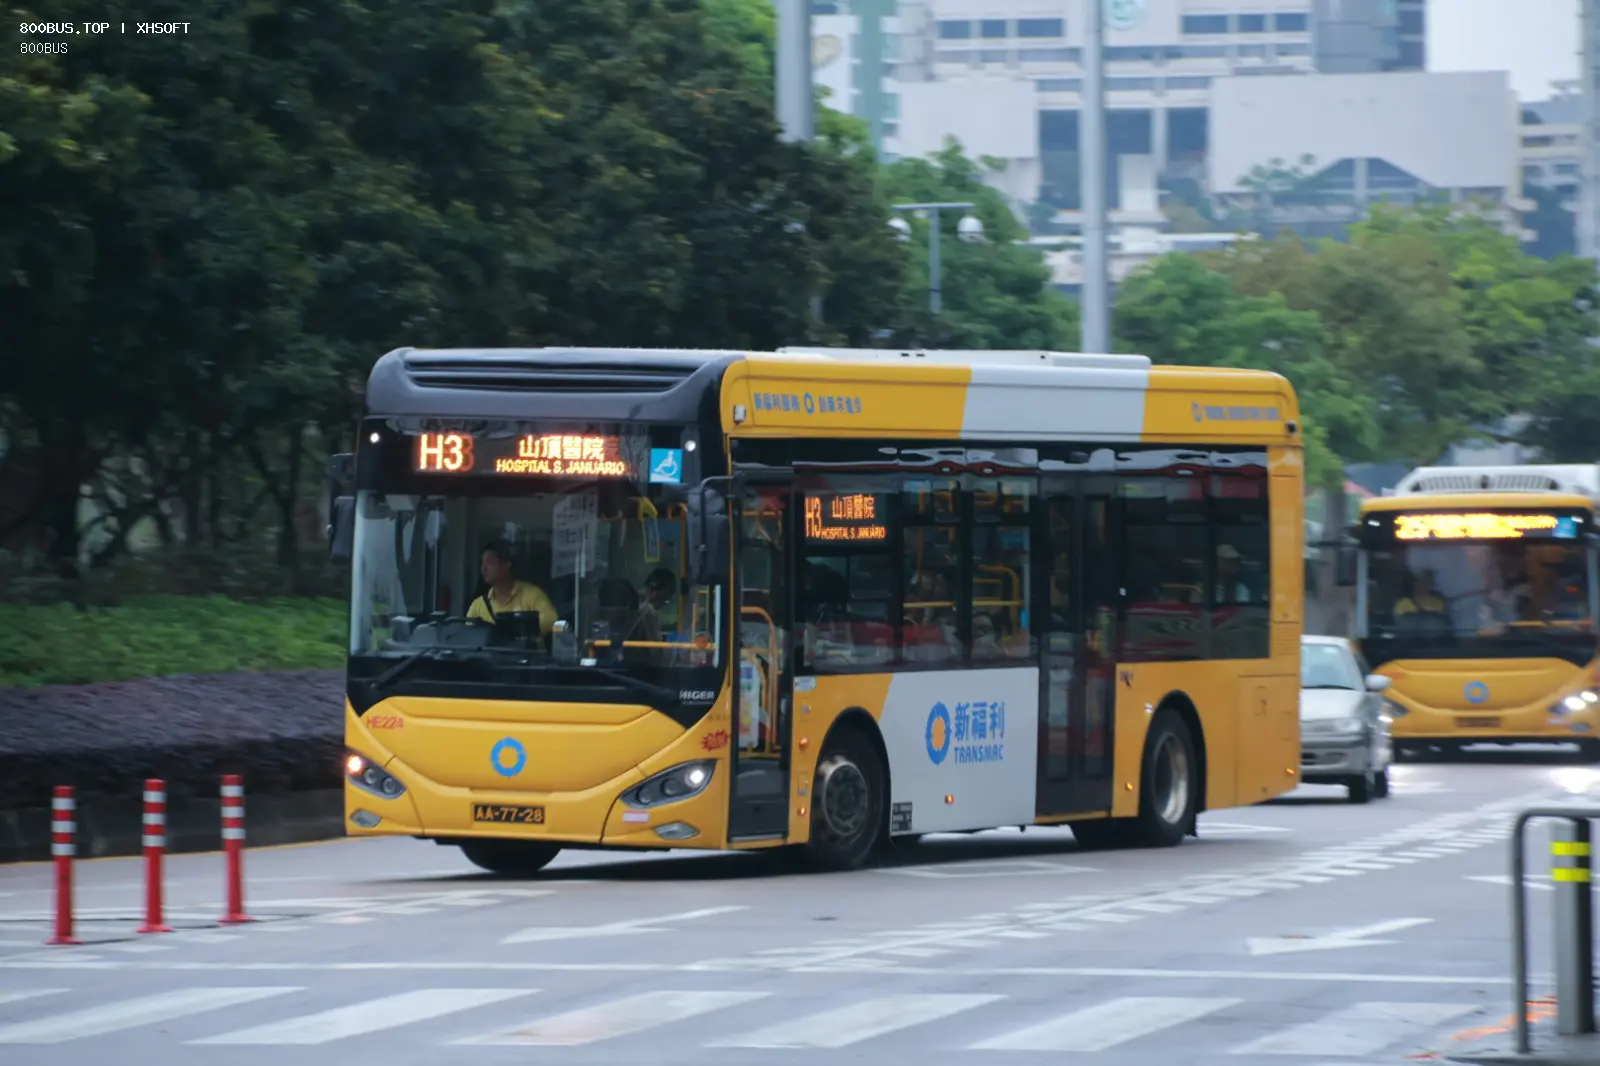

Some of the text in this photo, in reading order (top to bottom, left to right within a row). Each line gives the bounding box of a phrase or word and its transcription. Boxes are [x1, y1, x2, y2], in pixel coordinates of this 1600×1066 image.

[419, 433, 463, 471] H3
[518, 434, 606, 461] 山頂醫院
[495, 458, 551, 474] HOSPITAL
[805, 496, 822, 538] H3
[831, 494, 876, 519] 山頂醫院
[366, 715, 404, 730] HE224
[954, 701, 1005, 741] 新福利
[954, 744, 1004, 764] TRANSMAC
[475, 805, 544, 823] AA-77-28
